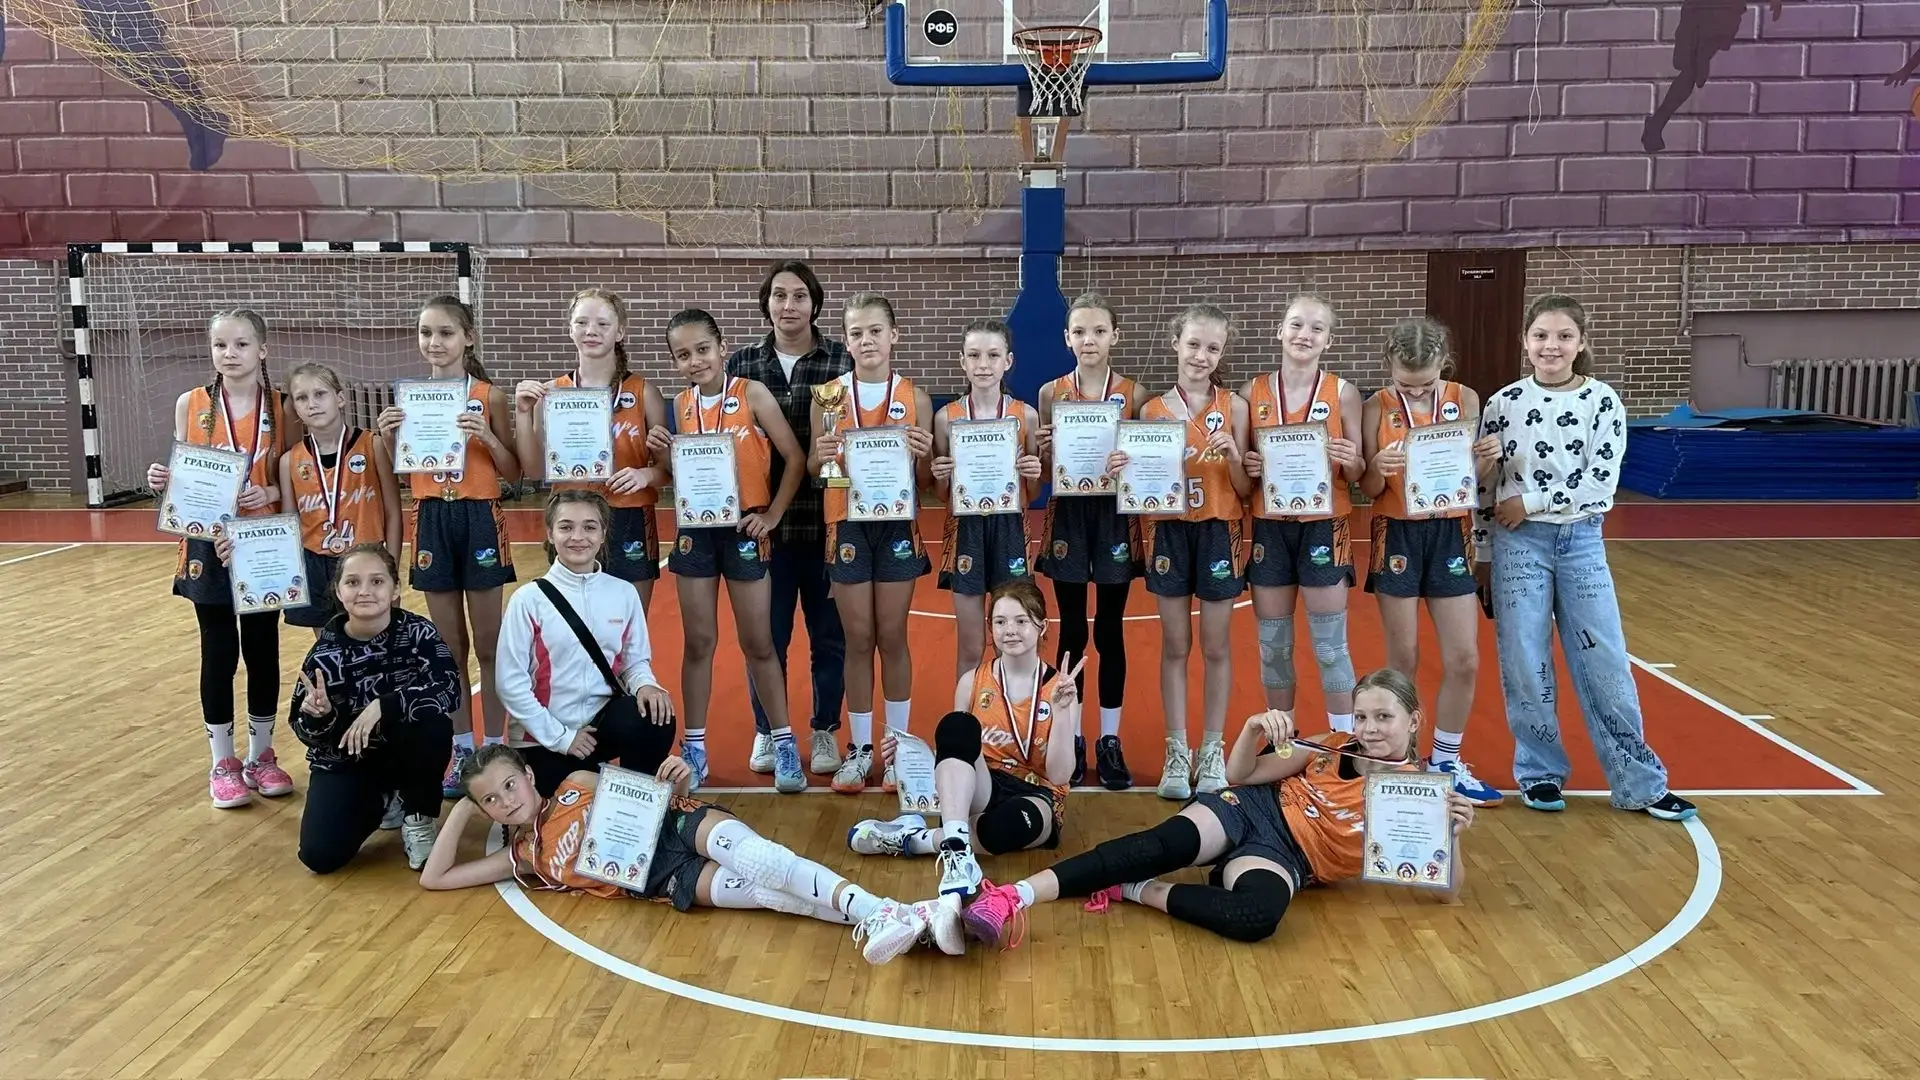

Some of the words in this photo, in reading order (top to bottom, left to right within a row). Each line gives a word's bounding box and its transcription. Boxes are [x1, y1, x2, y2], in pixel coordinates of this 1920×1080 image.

[928, 22, 955, 34] РФБ
[409, 393, 455, 401] ГРАМОТА
[554, 401, 599, 410] ГРАМОТА
[1064, 415, 1108, 423] ГРАМОТА
[962, 433, 1006, 443] ГРАМОТА
[1128, 434, 1172, 442] ГРАМОТА
[1269, 433, 1316, 443] ГРАМОТА
[1417, 430, 1464, 441] ГРАМОТА
[855, 440, 900, 449] ГРАМОТА
[682, 447, 724, 456] ГРАМОТА
[184, 456, 232, 473] ГРАМОТА
[238, 527, 287, 539] ГРАМОТА
[322, 519, 355, 551] 24
[1540, 686, 1553, 703] My
[608, 783, 654, 803] ГРАМОТА
[1380, 785, 1438, 798] ГРАМОТА
